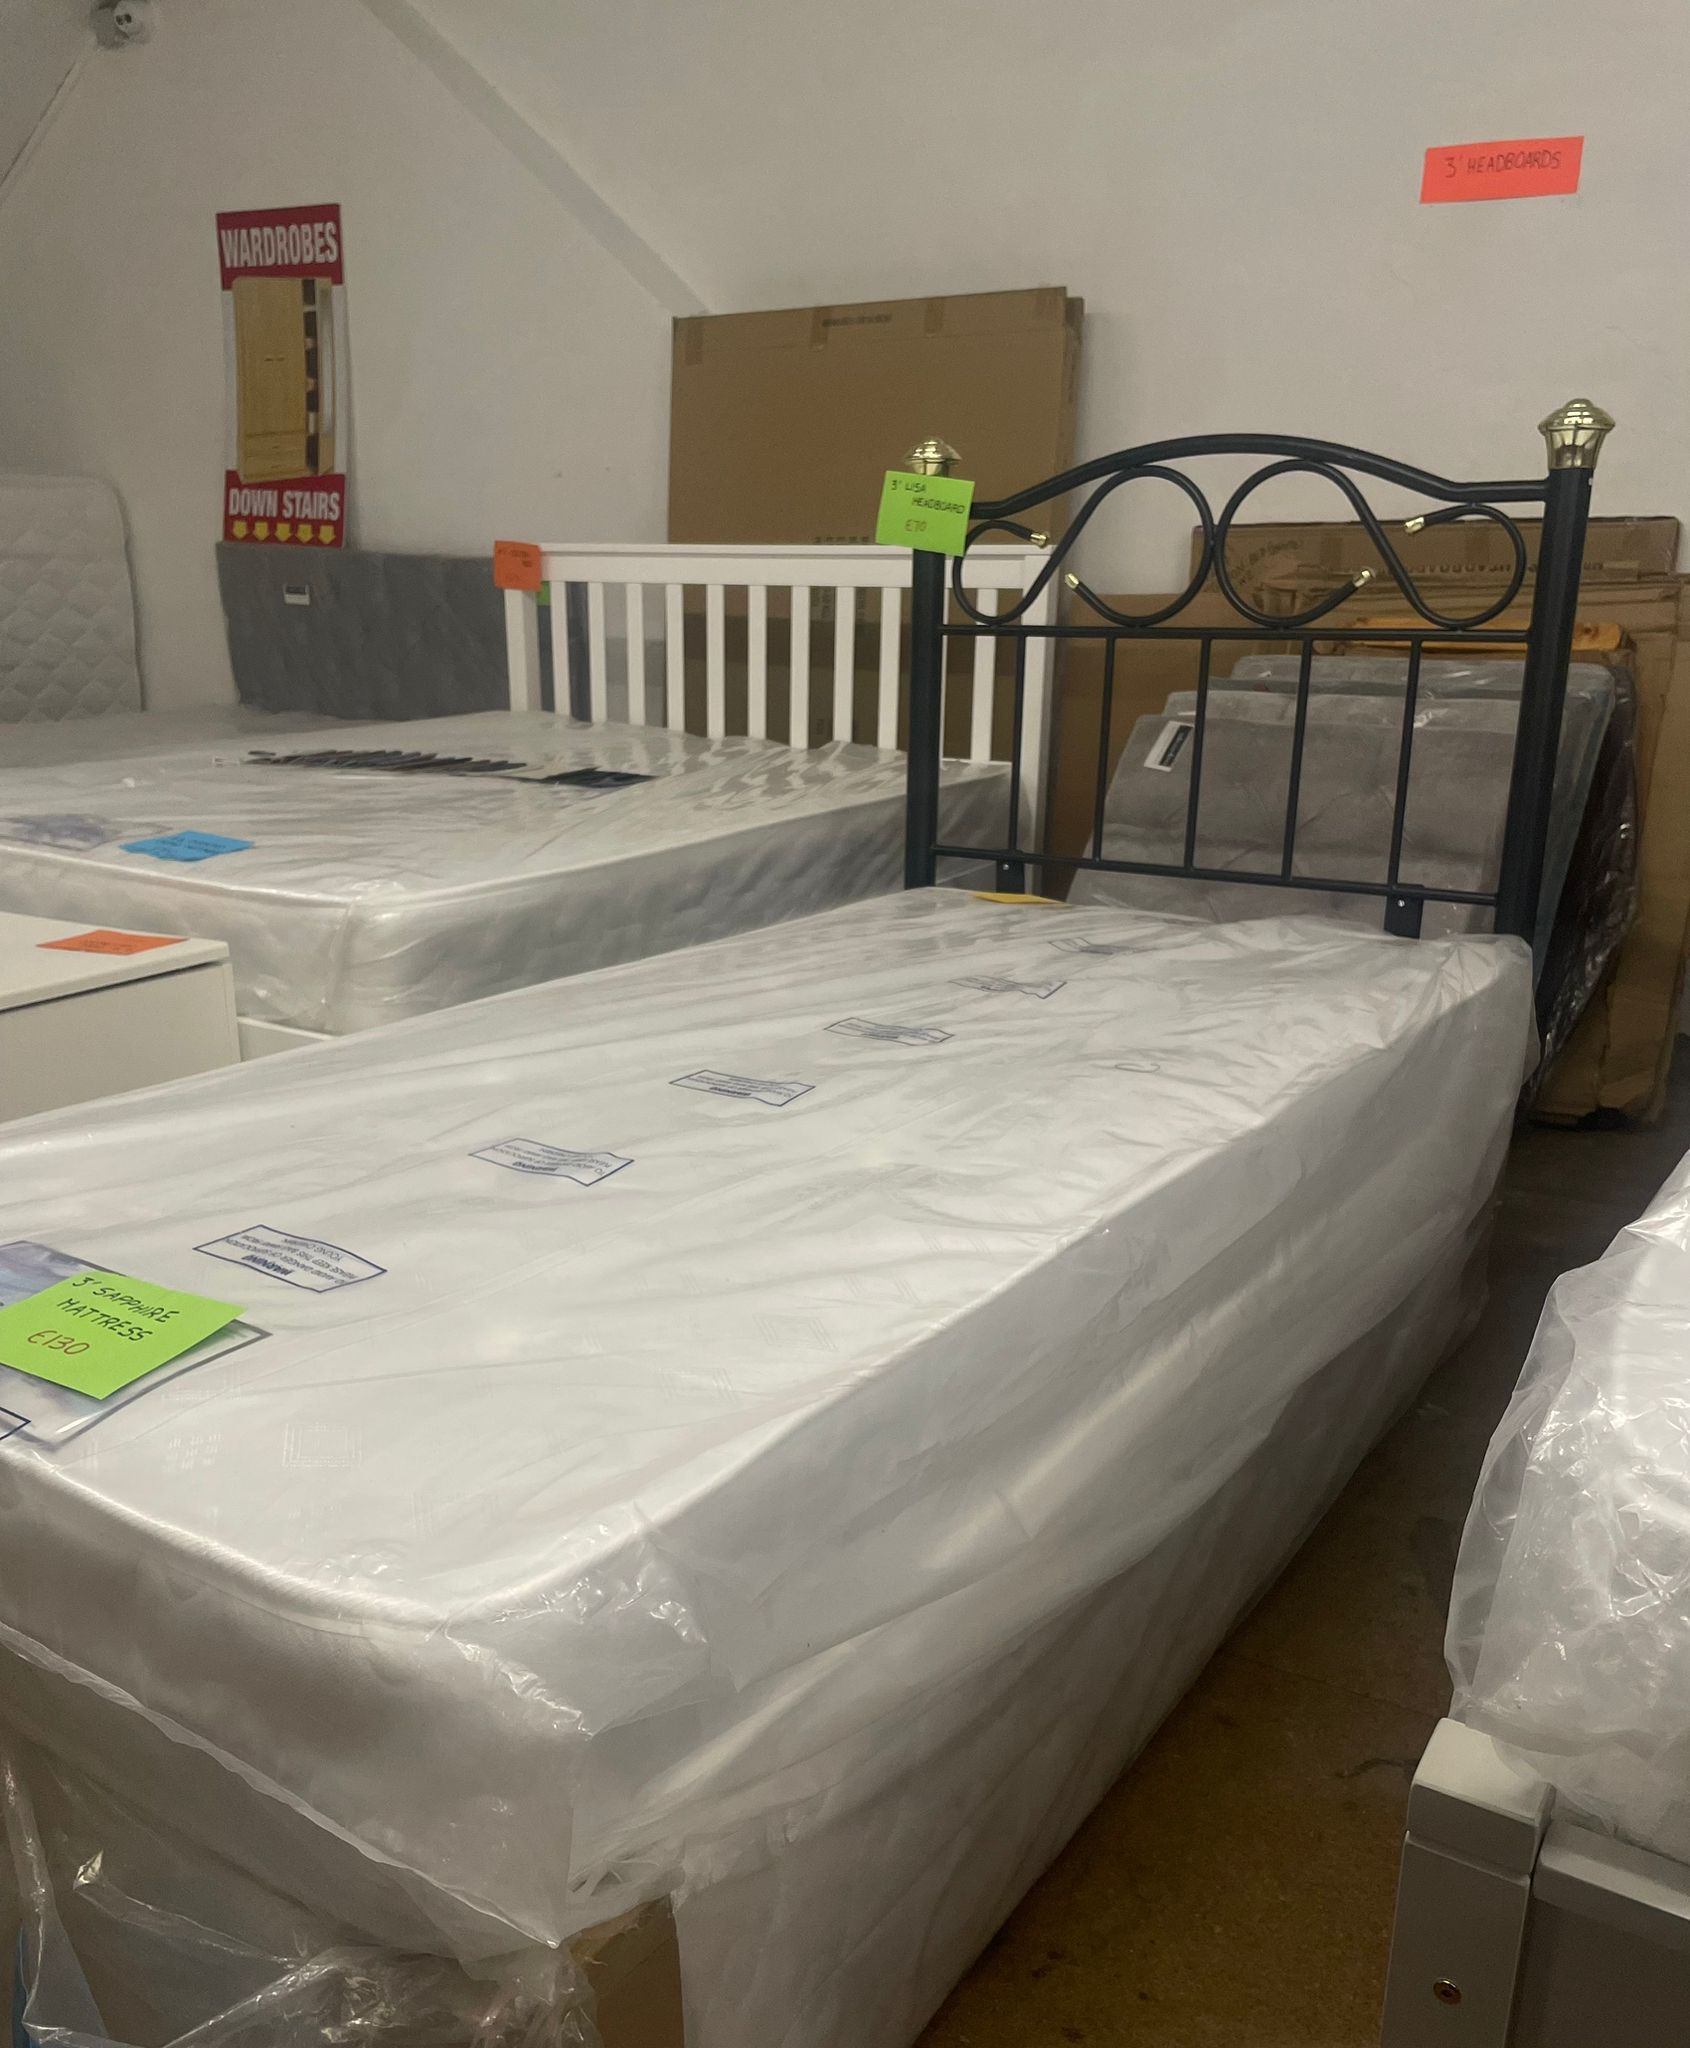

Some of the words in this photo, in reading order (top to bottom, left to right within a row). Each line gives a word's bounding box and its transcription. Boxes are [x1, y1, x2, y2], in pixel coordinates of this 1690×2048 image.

[1444, 155, 1464, 179] 3'
[1467, 150, 1562, 174] HEADBOARDS
[220, 221, 338, 268] WARDROBES
[228, 488, 278, 518] DOWN
[282, 491, 341, 522] STAIRS
[911, 497, 966, 515] HEADBOARD
[72, 1276, 102, 1287] 3'
[92, 1287, 180, 1323] SAPPHIRE
[56, 1298, 153, 1341] MATTRESS
